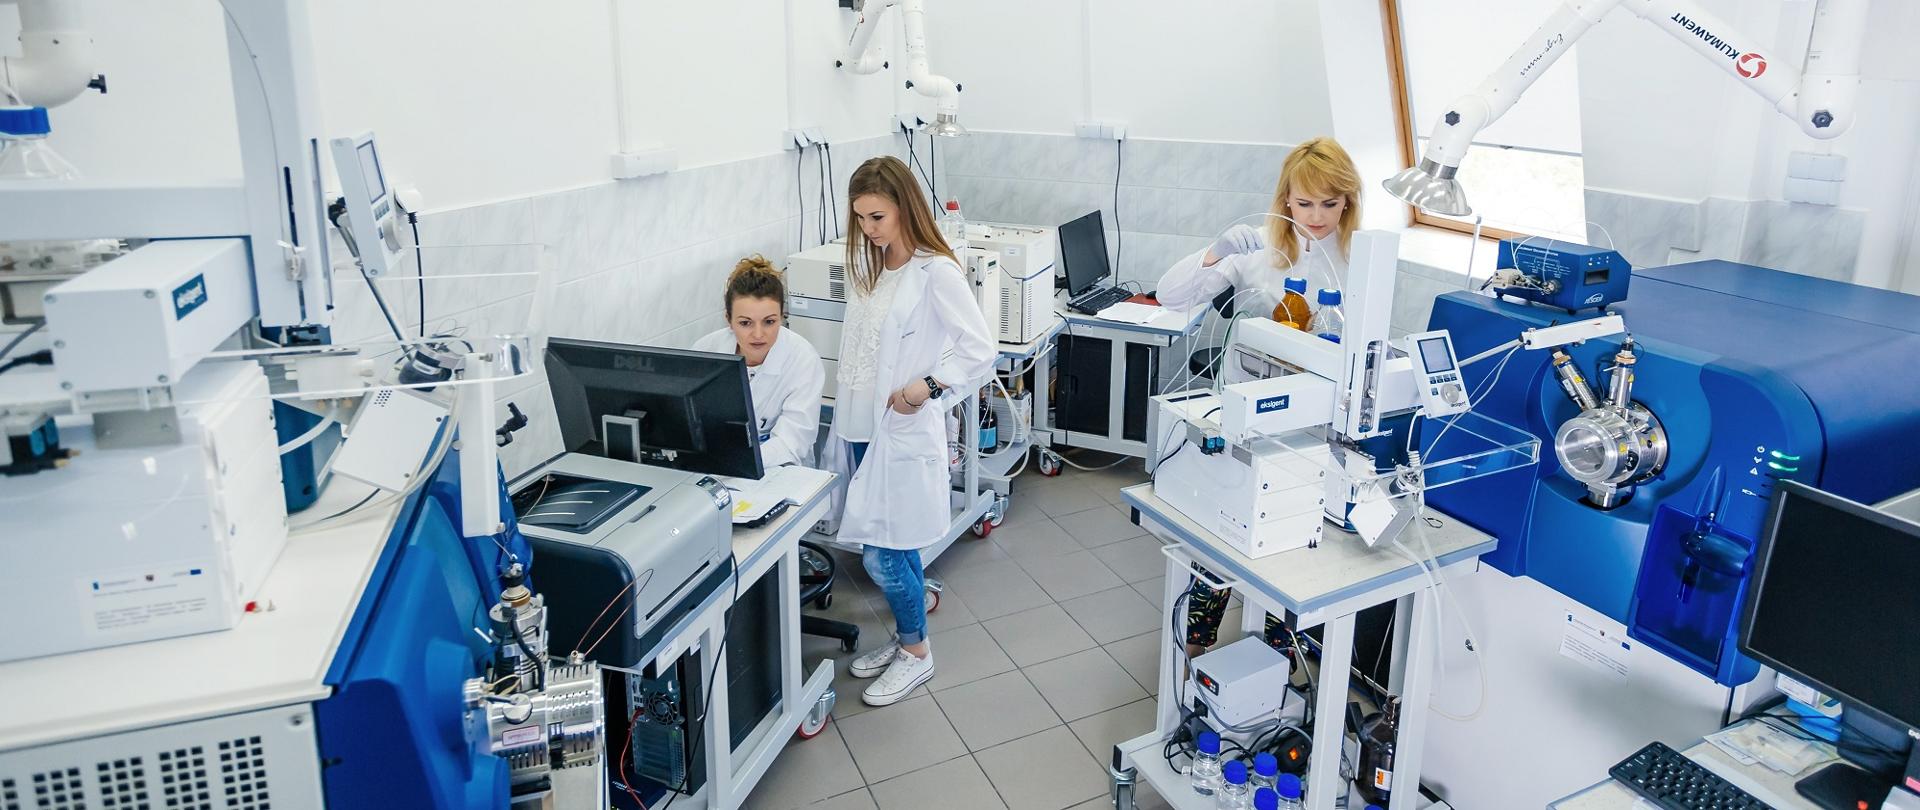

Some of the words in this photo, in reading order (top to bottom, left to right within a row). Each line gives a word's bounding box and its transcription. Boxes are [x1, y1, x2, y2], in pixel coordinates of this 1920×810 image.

[1671, 12, 1740, 60] KLIMAWENT
[614, 354, 655, 372] DELL
[1260, 399, 1285, 409] eksigent
